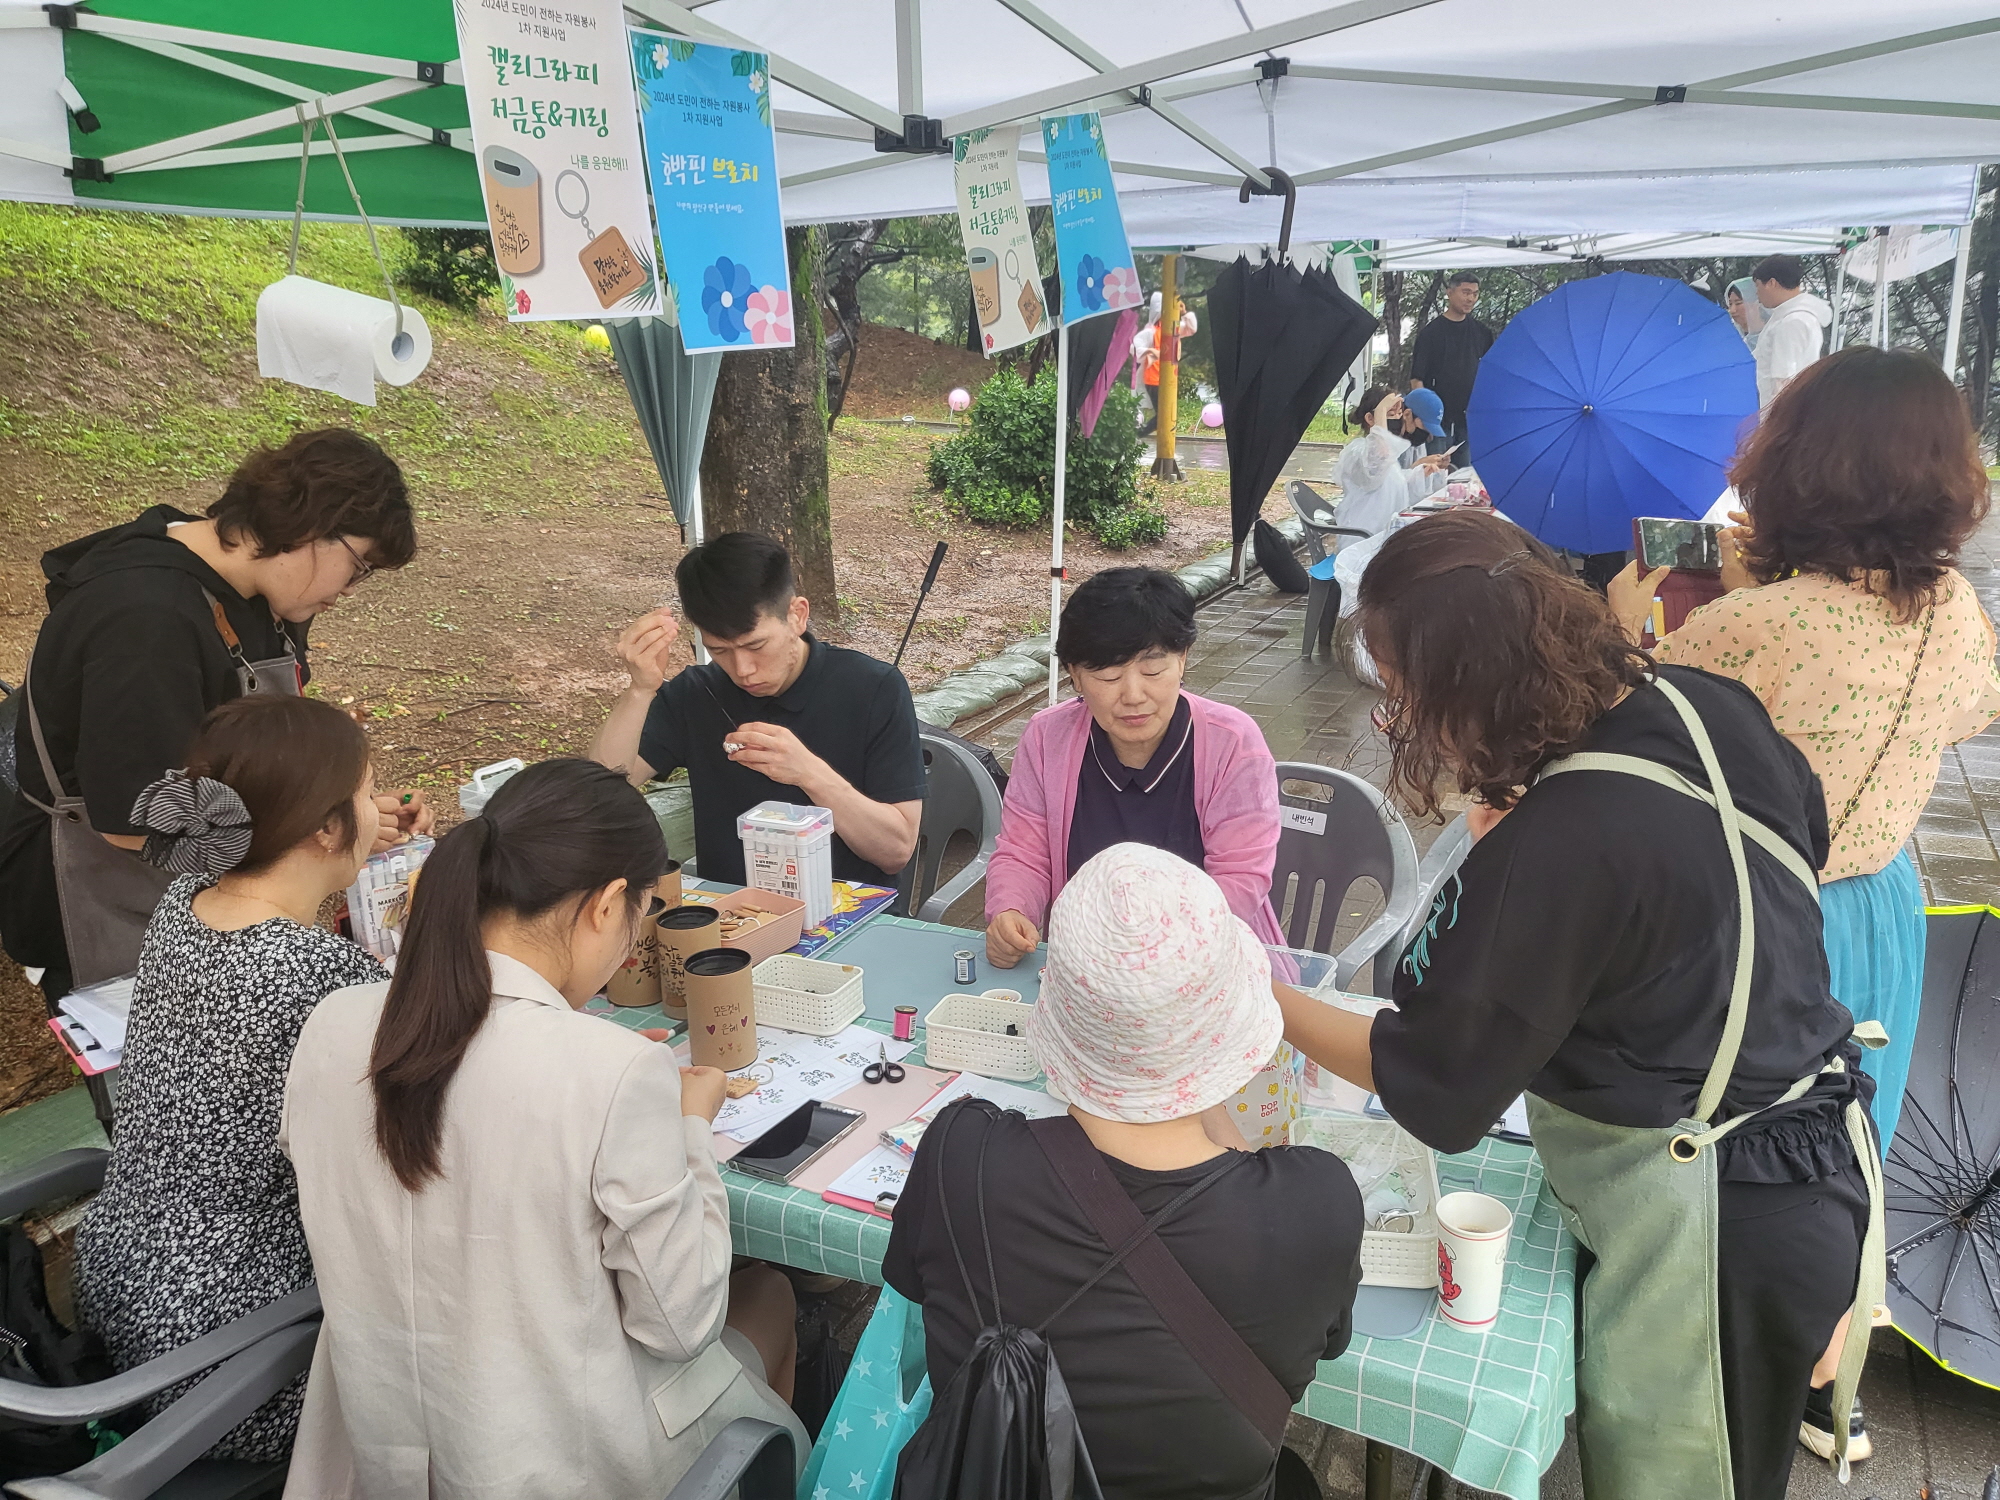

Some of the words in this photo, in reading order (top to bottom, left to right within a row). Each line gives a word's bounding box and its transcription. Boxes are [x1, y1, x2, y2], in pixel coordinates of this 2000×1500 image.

[481, 0, 510, 14] 2024년
[512, 3, 537, 19] 도민이
[540, 8, 563, 23] 전하는
[565, 13, 597, 30] 자원봉사
[518, 22, 532, 35] 1차
[534, 26, 566, 42] 지원사업
[487, 45, 599, 86] 캘리그라피
[653, 91, 675, 105] 2024년
[677, 94, 698, 108] 도민이
[700, 97, 721, 111] 전하는
[722, 100, 751, 114] 자원봉사
[491, 96, 609, 139] 저금통&키링
[682, 112, 694, 125] 1차
[695, 113, 723, 127] 지원사업
[571, 154, 590, 170] 나를
[592, 156, 629, 171] 응원해!!
[661, 152, 706, 186] 호박핀
[712, 157, 758, 184] 브로치
[968, 177, 1012, 210] 캘리그라피
[1291, 813, 1315, 827] 내빈석
[1261, 1100, 1278, 1112] POP
